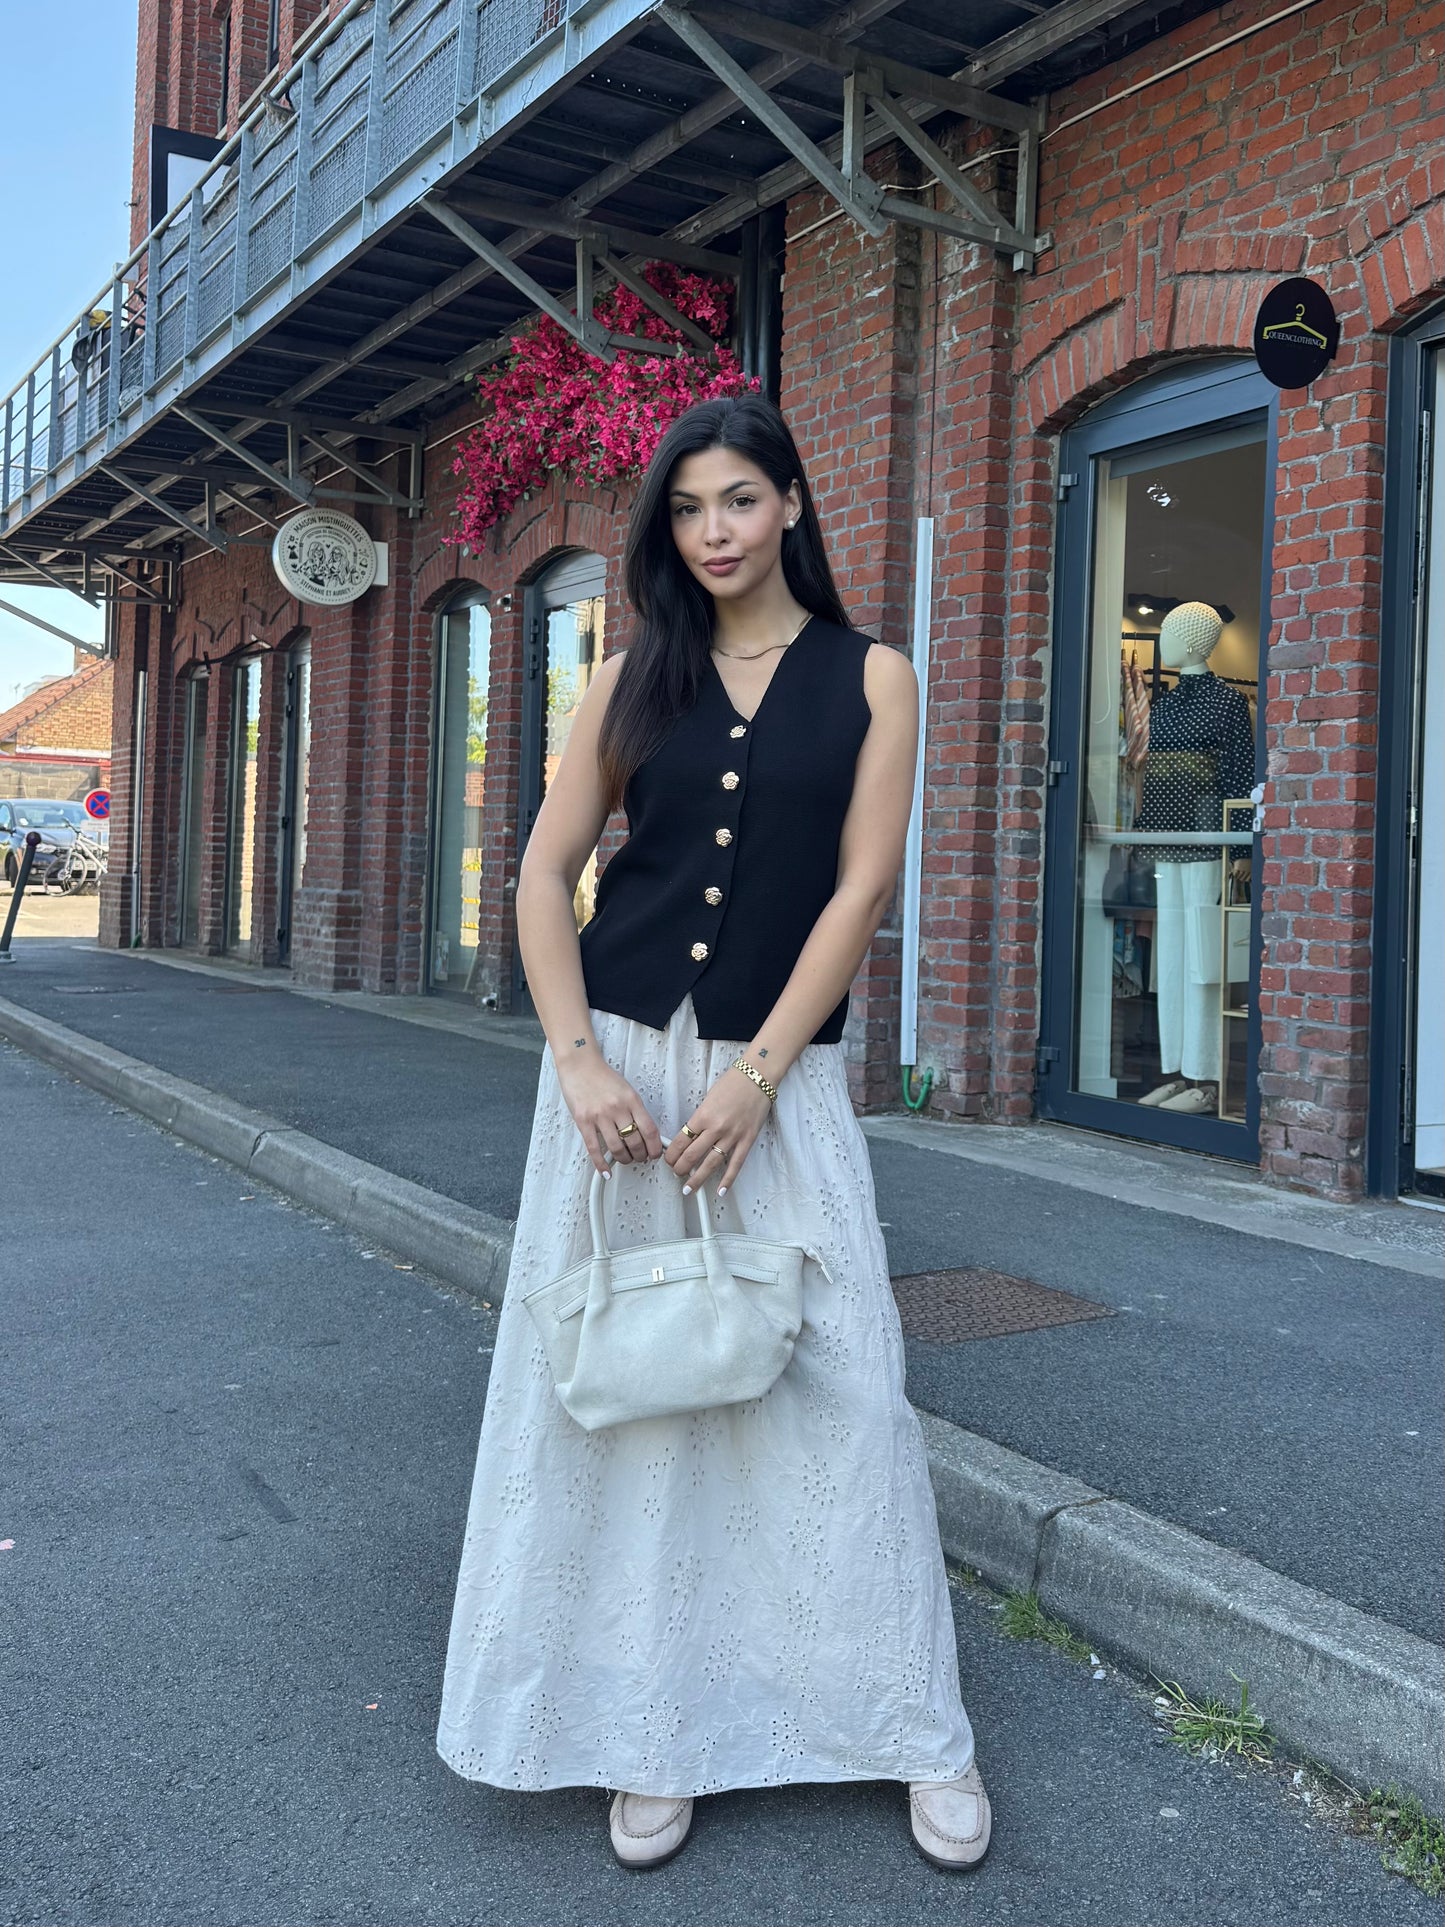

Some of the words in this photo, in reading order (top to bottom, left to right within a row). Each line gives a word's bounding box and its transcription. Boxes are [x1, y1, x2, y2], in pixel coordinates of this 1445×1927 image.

[1268, 331, 1322, 347] QUEENCLOTHING
[293, 517, 317, 533] MAISON
[318, 516, 363, 543] MISTINGUETTES
[574, 1038, 586, 1048] 30
